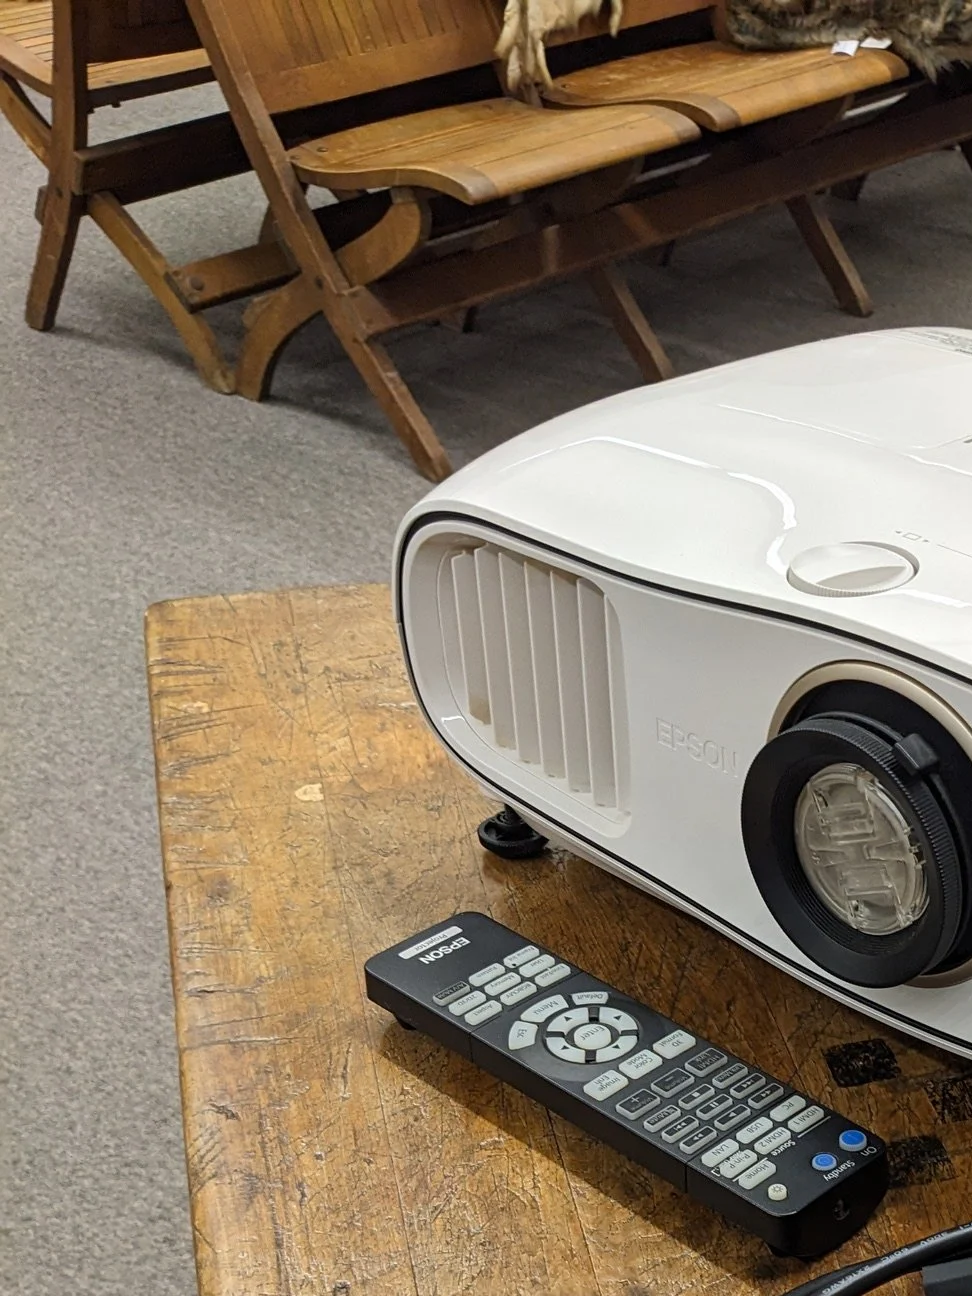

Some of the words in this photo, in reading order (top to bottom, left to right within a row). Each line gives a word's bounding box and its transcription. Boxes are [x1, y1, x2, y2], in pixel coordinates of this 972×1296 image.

[656, 717, 739, 778] EPSON
[414, 933, 449, 952] Projector
[418, 936, 471, 965] EPSON
[530, 958, 544, 968] User
[490, 975, 515, 988] Memory
[505, 983, 532, 998] RGBCMY
[474, 1003, 493, 1017] Aspect
[533, 1000, 559, 1015] Menu
[517, 1028, 528, 1038] Esc
[580, 1025, 605, 1041] Enter
[659, 1032, 684, 1047] Format
[628, 1053, 648, 1066] Mode
[634, 1057, 653, 1069] Color
[698, 1055, 719, 1070] HDMI
[594, 1074, 610, 1086] Enh
[598, 1077, 620, 1092] Image
[781, 1101, 795, 1110] PC
[803, 1107, 819, 1122] HDMI
[747, 1122, 763, 1134] USB
[770, 1128, 786, 1142] HDMI
[711, 1144, 730, 1157] LAN
[760, 1140, 767, 1148] 2
[771, 1139, 797, 1157] Source
[860, 1146, 878, 1157] On
[729, 1154, 751, 1170] P-in-P
[746, 1161, 769, 1179] Home
[823, 1159, 856, 1182] Standby
